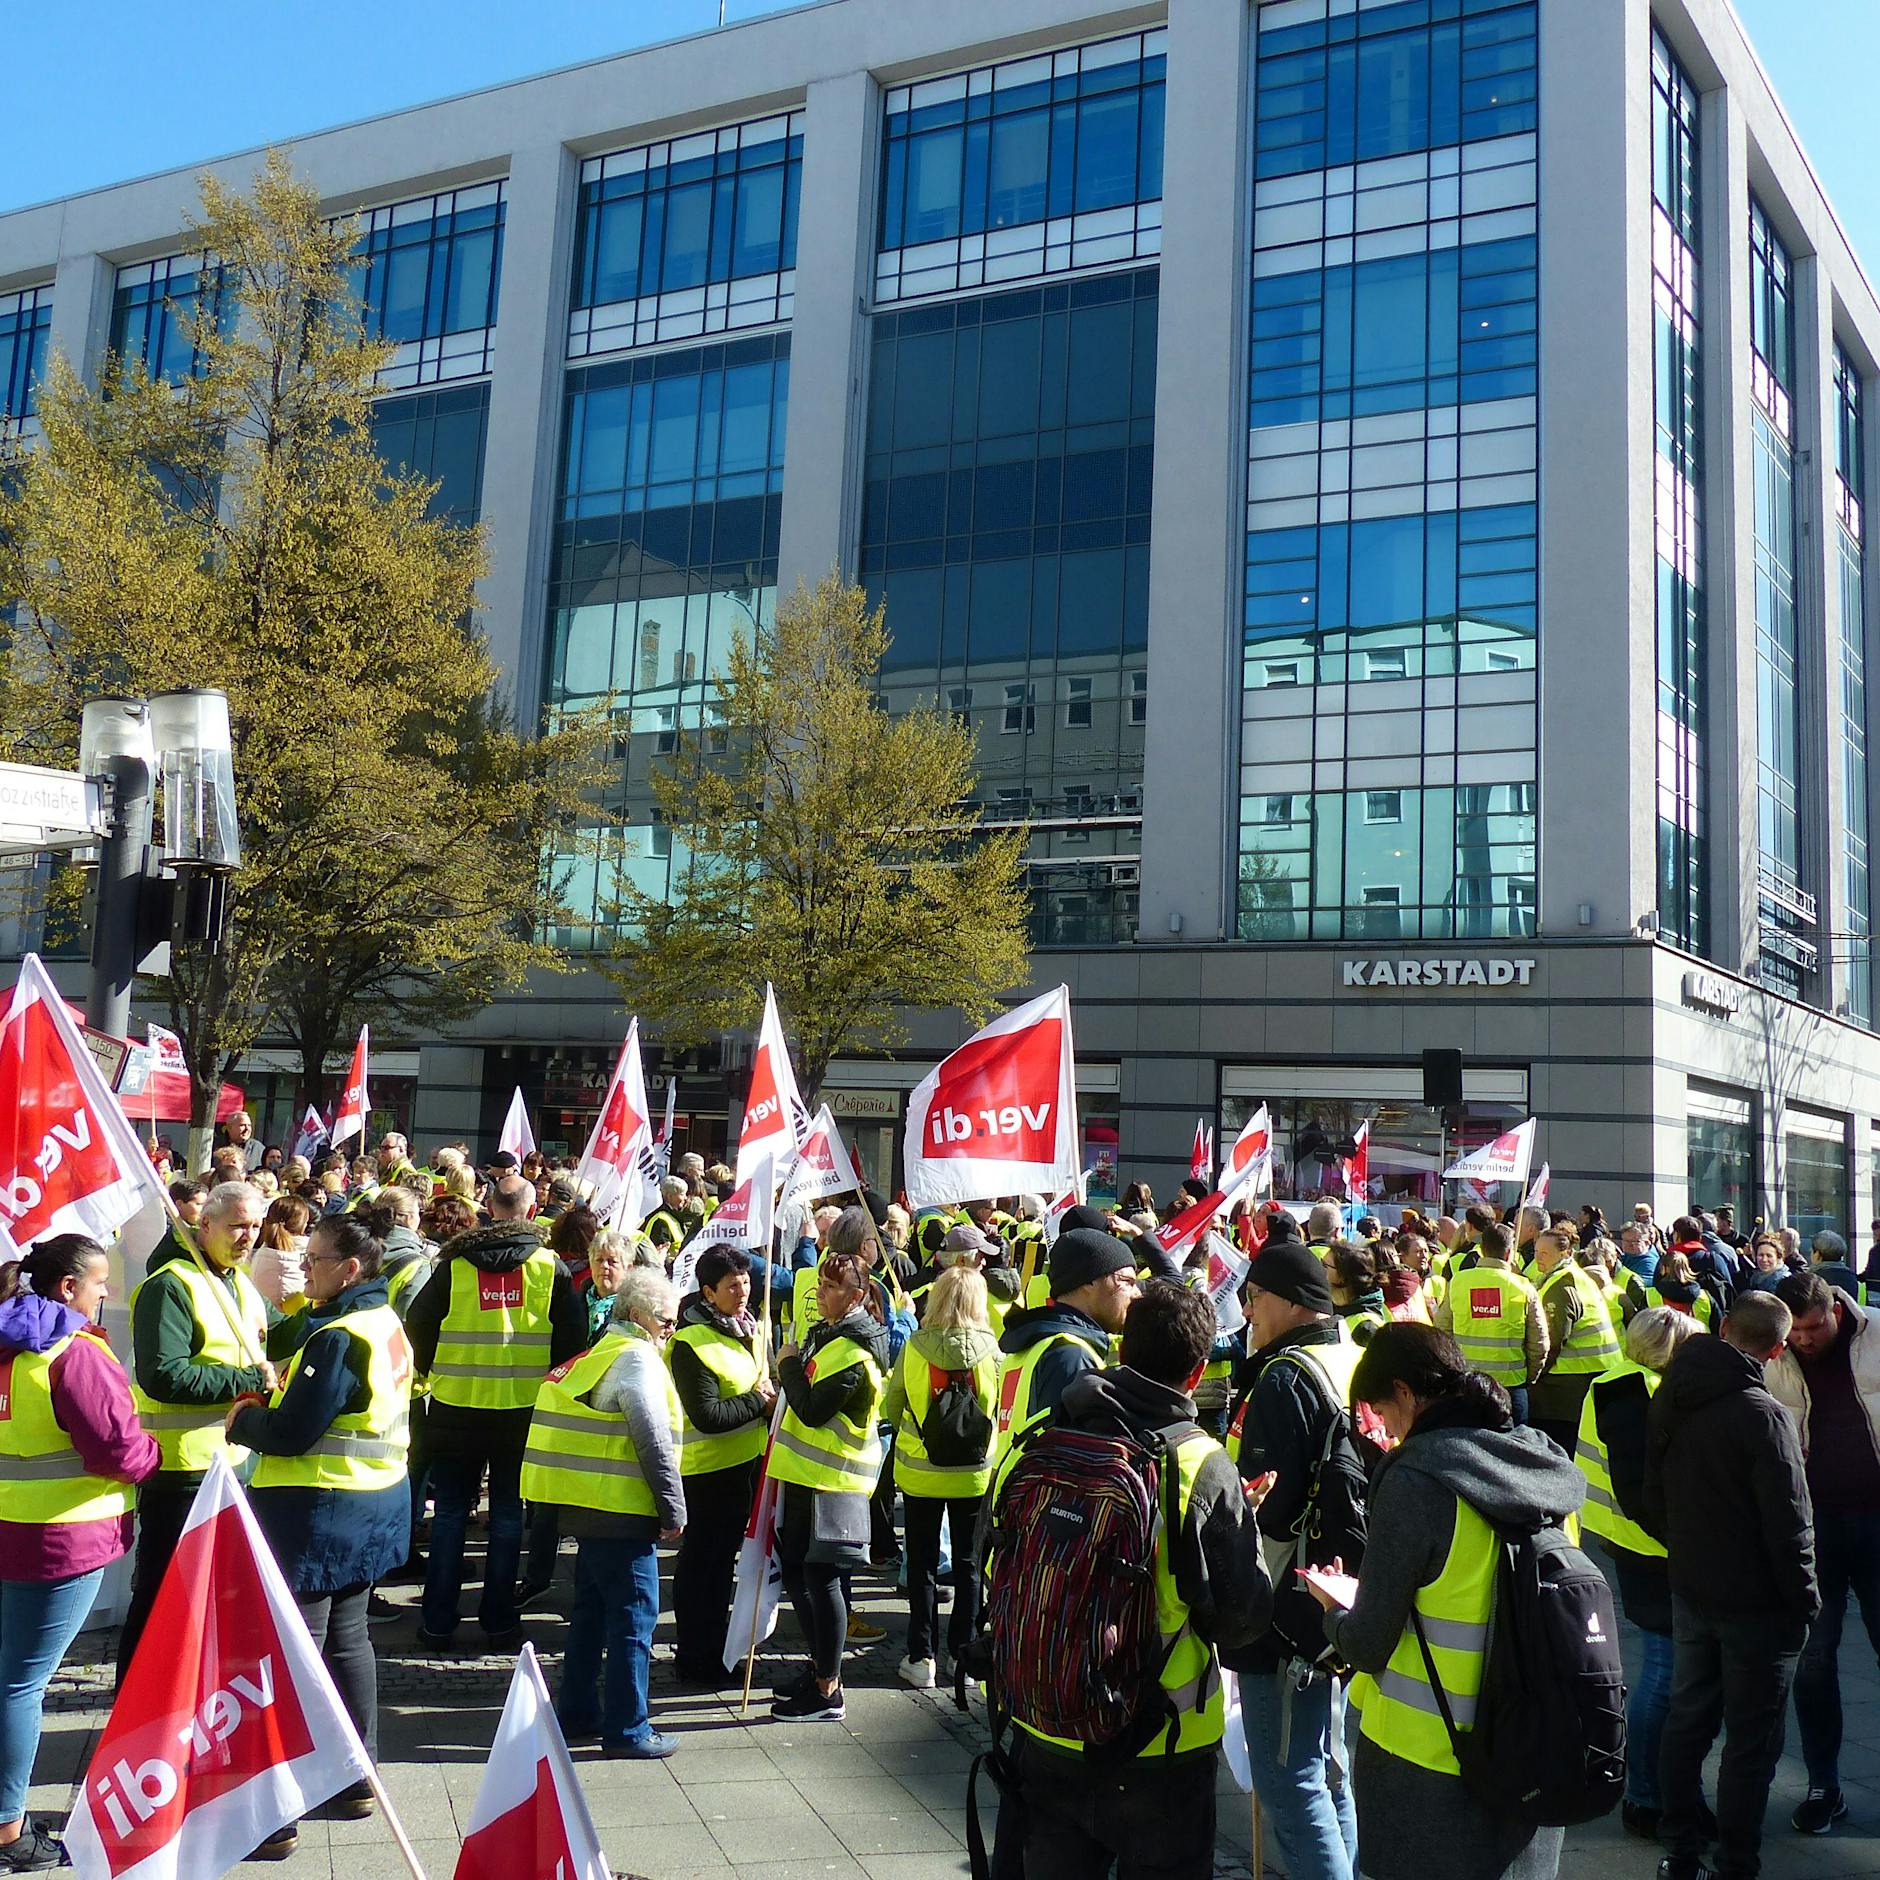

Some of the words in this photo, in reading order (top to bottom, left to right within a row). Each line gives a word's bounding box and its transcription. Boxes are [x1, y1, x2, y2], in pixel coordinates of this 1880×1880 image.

[1343, 959, 1535, 986] KARSTADT
[94, 1039, 113, 1054] 150
[583, 1072, 673, 1090] KADT
[834, 1093, 885, 1115] Crêperie
[1472, 1305, 1499, 1314] ver.di
[1050, 1506, 1084, 1524] BURTON
